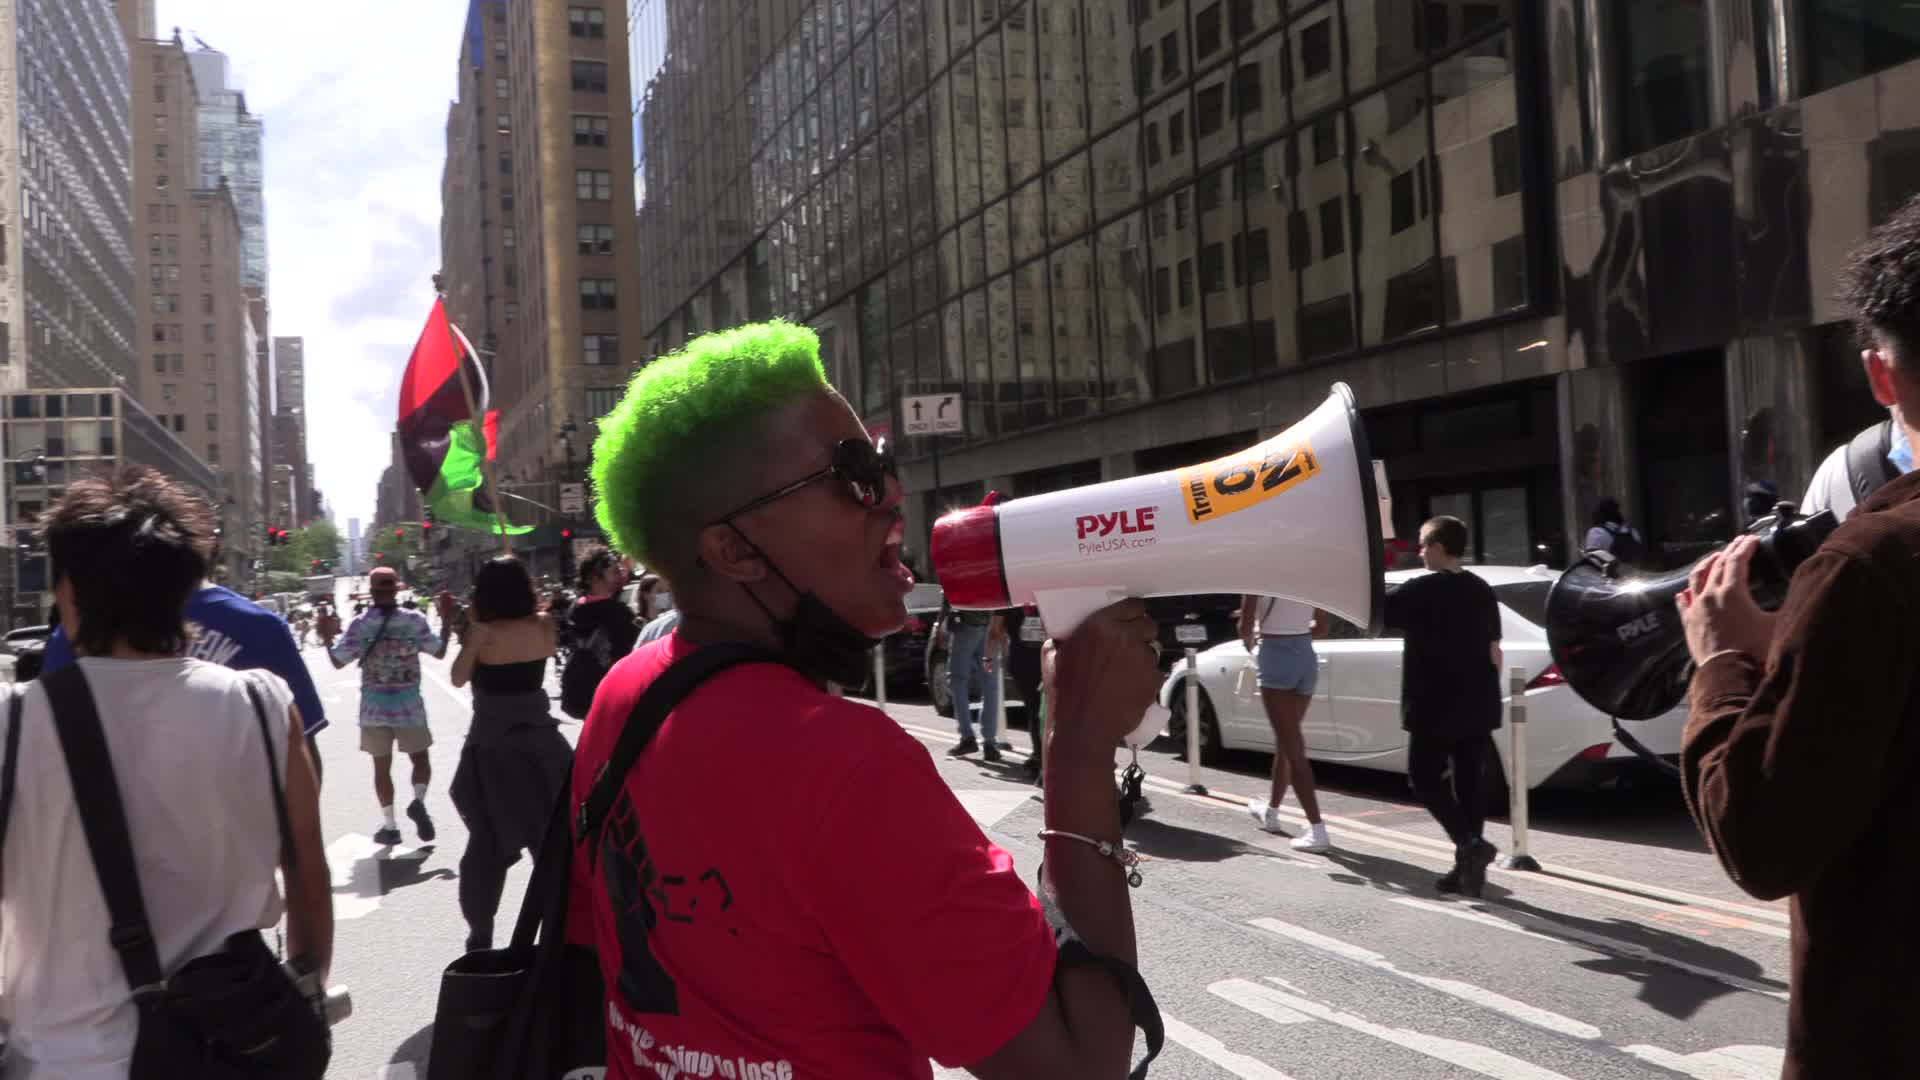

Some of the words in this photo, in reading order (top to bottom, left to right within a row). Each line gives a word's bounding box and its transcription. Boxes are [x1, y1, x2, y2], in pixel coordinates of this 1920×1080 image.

[1189, 478, 1214, 521] Trum
[1076, 506, 1155, 540] PYLE
[1078, 537, 1157, 556] PyleUSA.com
[1616, 611, 1660, 640] PYLE
[737, 1056, 793, 1080] lose
